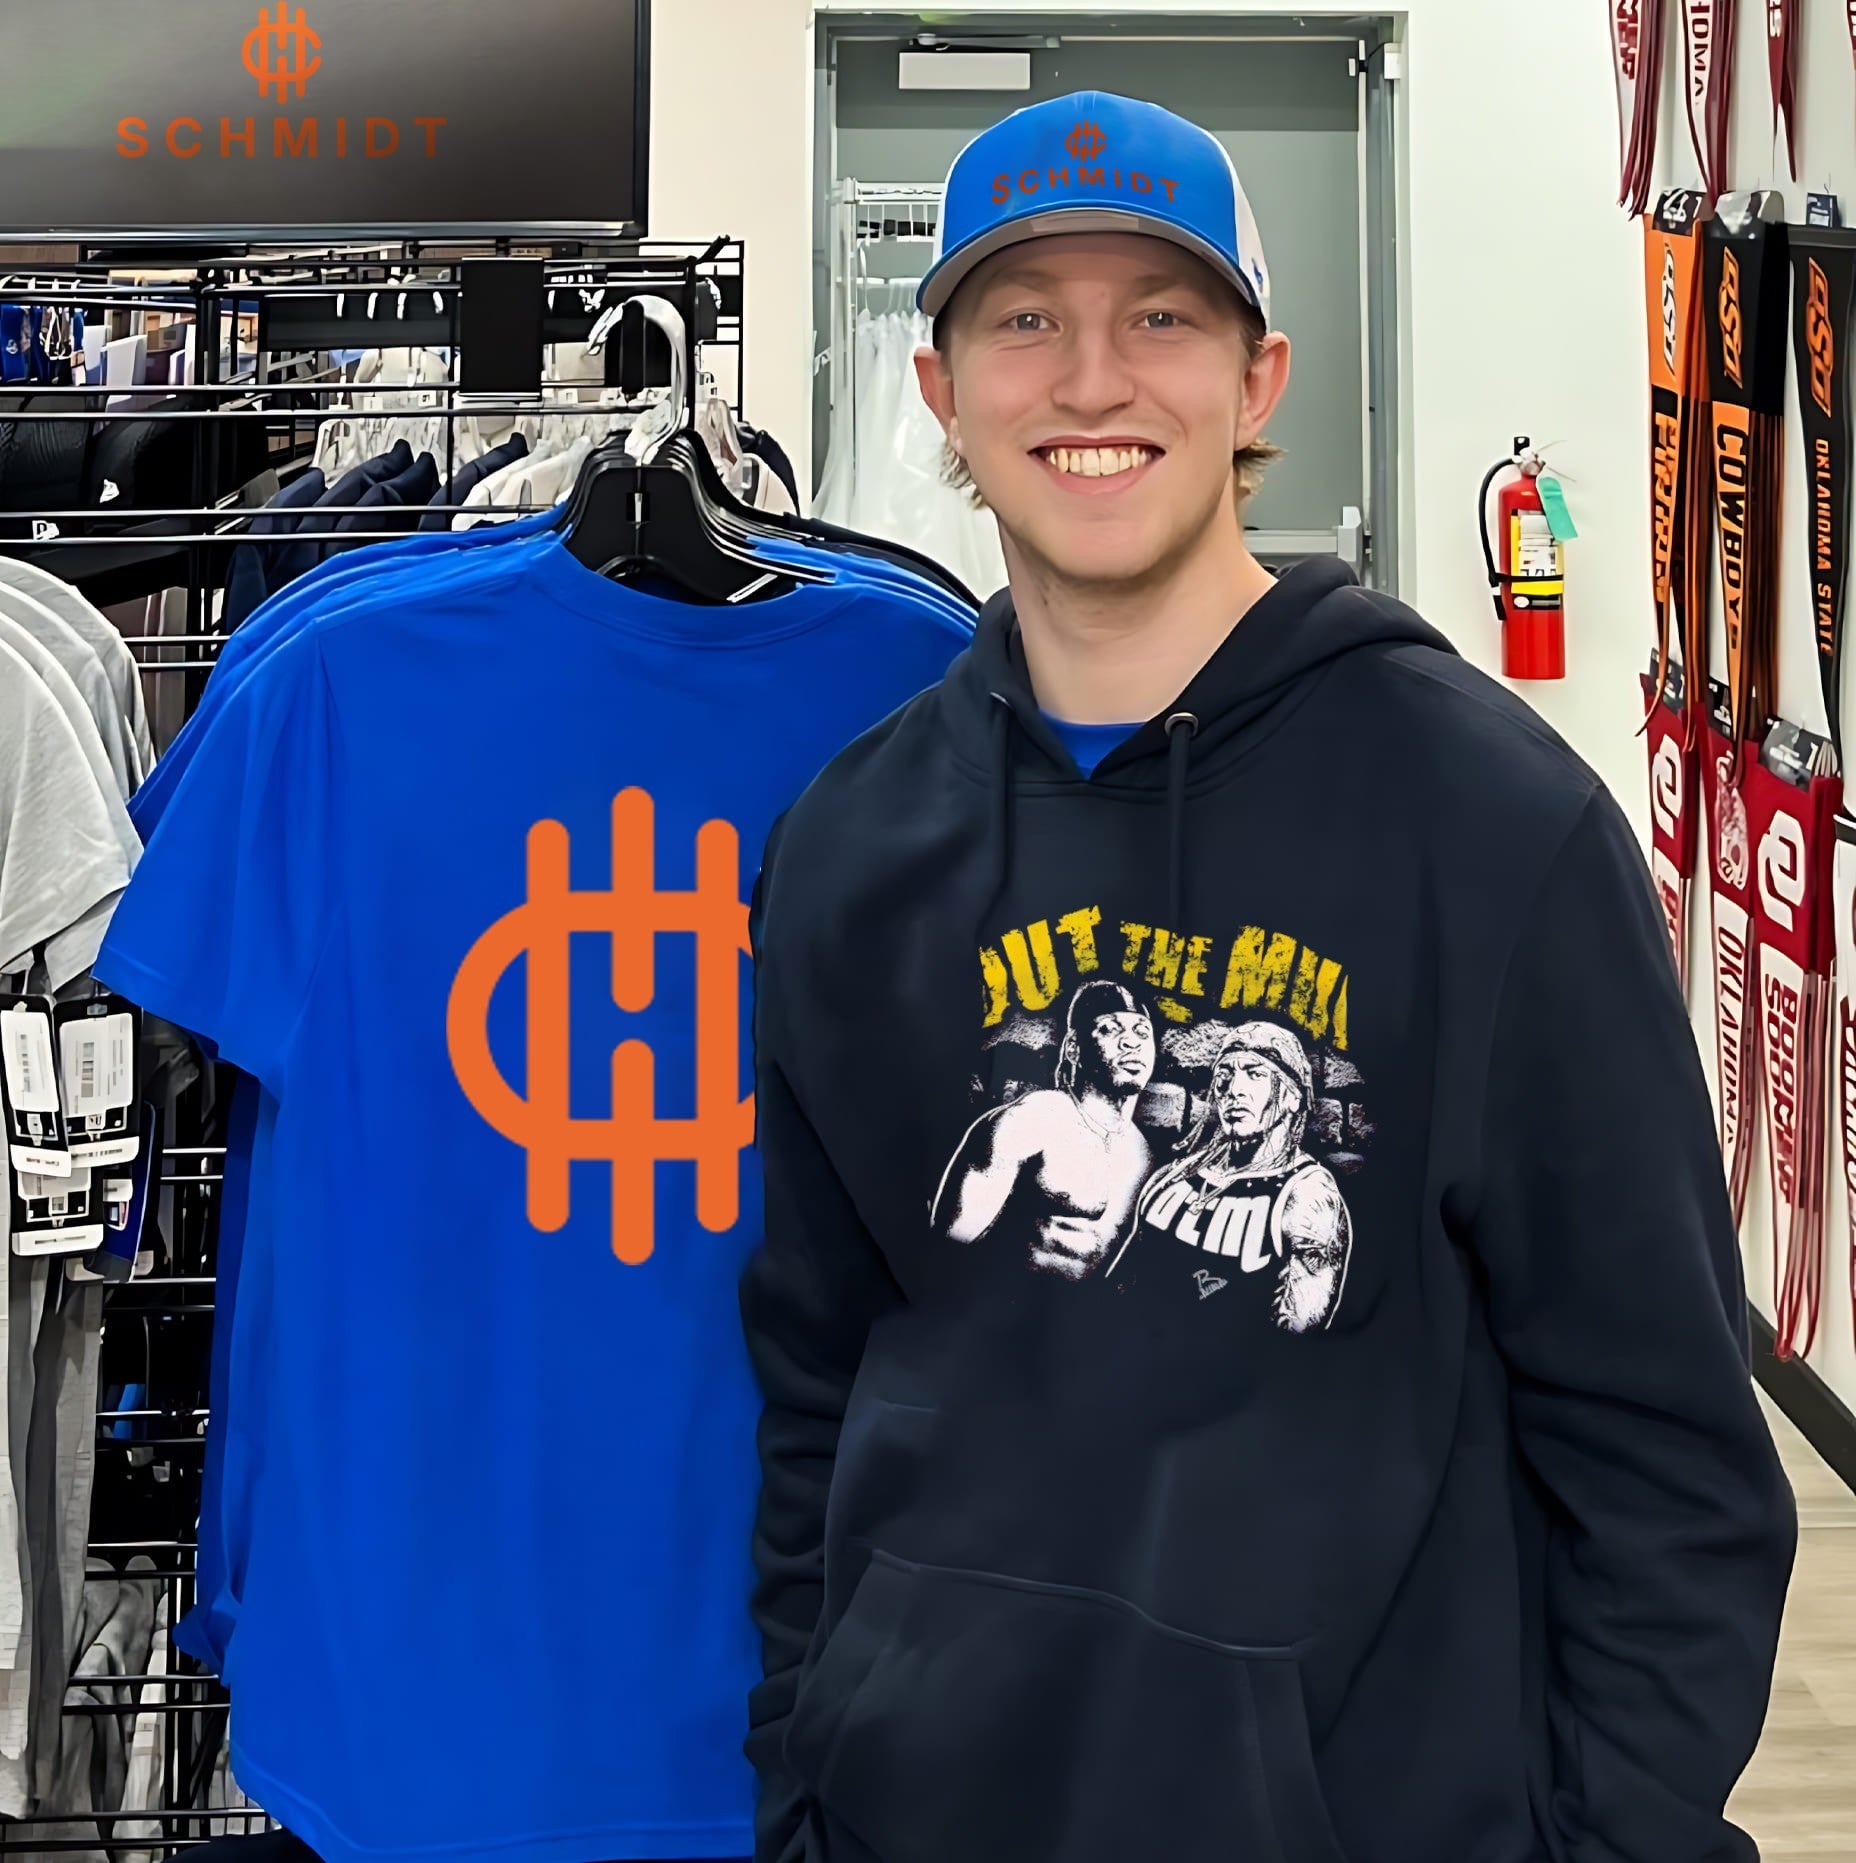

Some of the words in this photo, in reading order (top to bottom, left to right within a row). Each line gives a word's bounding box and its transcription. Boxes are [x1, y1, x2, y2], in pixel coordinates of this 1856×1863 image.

[115, 117, 447, 158] SCHMIDT
[991, 167, 1179, 205] SCHMIDT
[1120, 920, 1213, 996] THE
